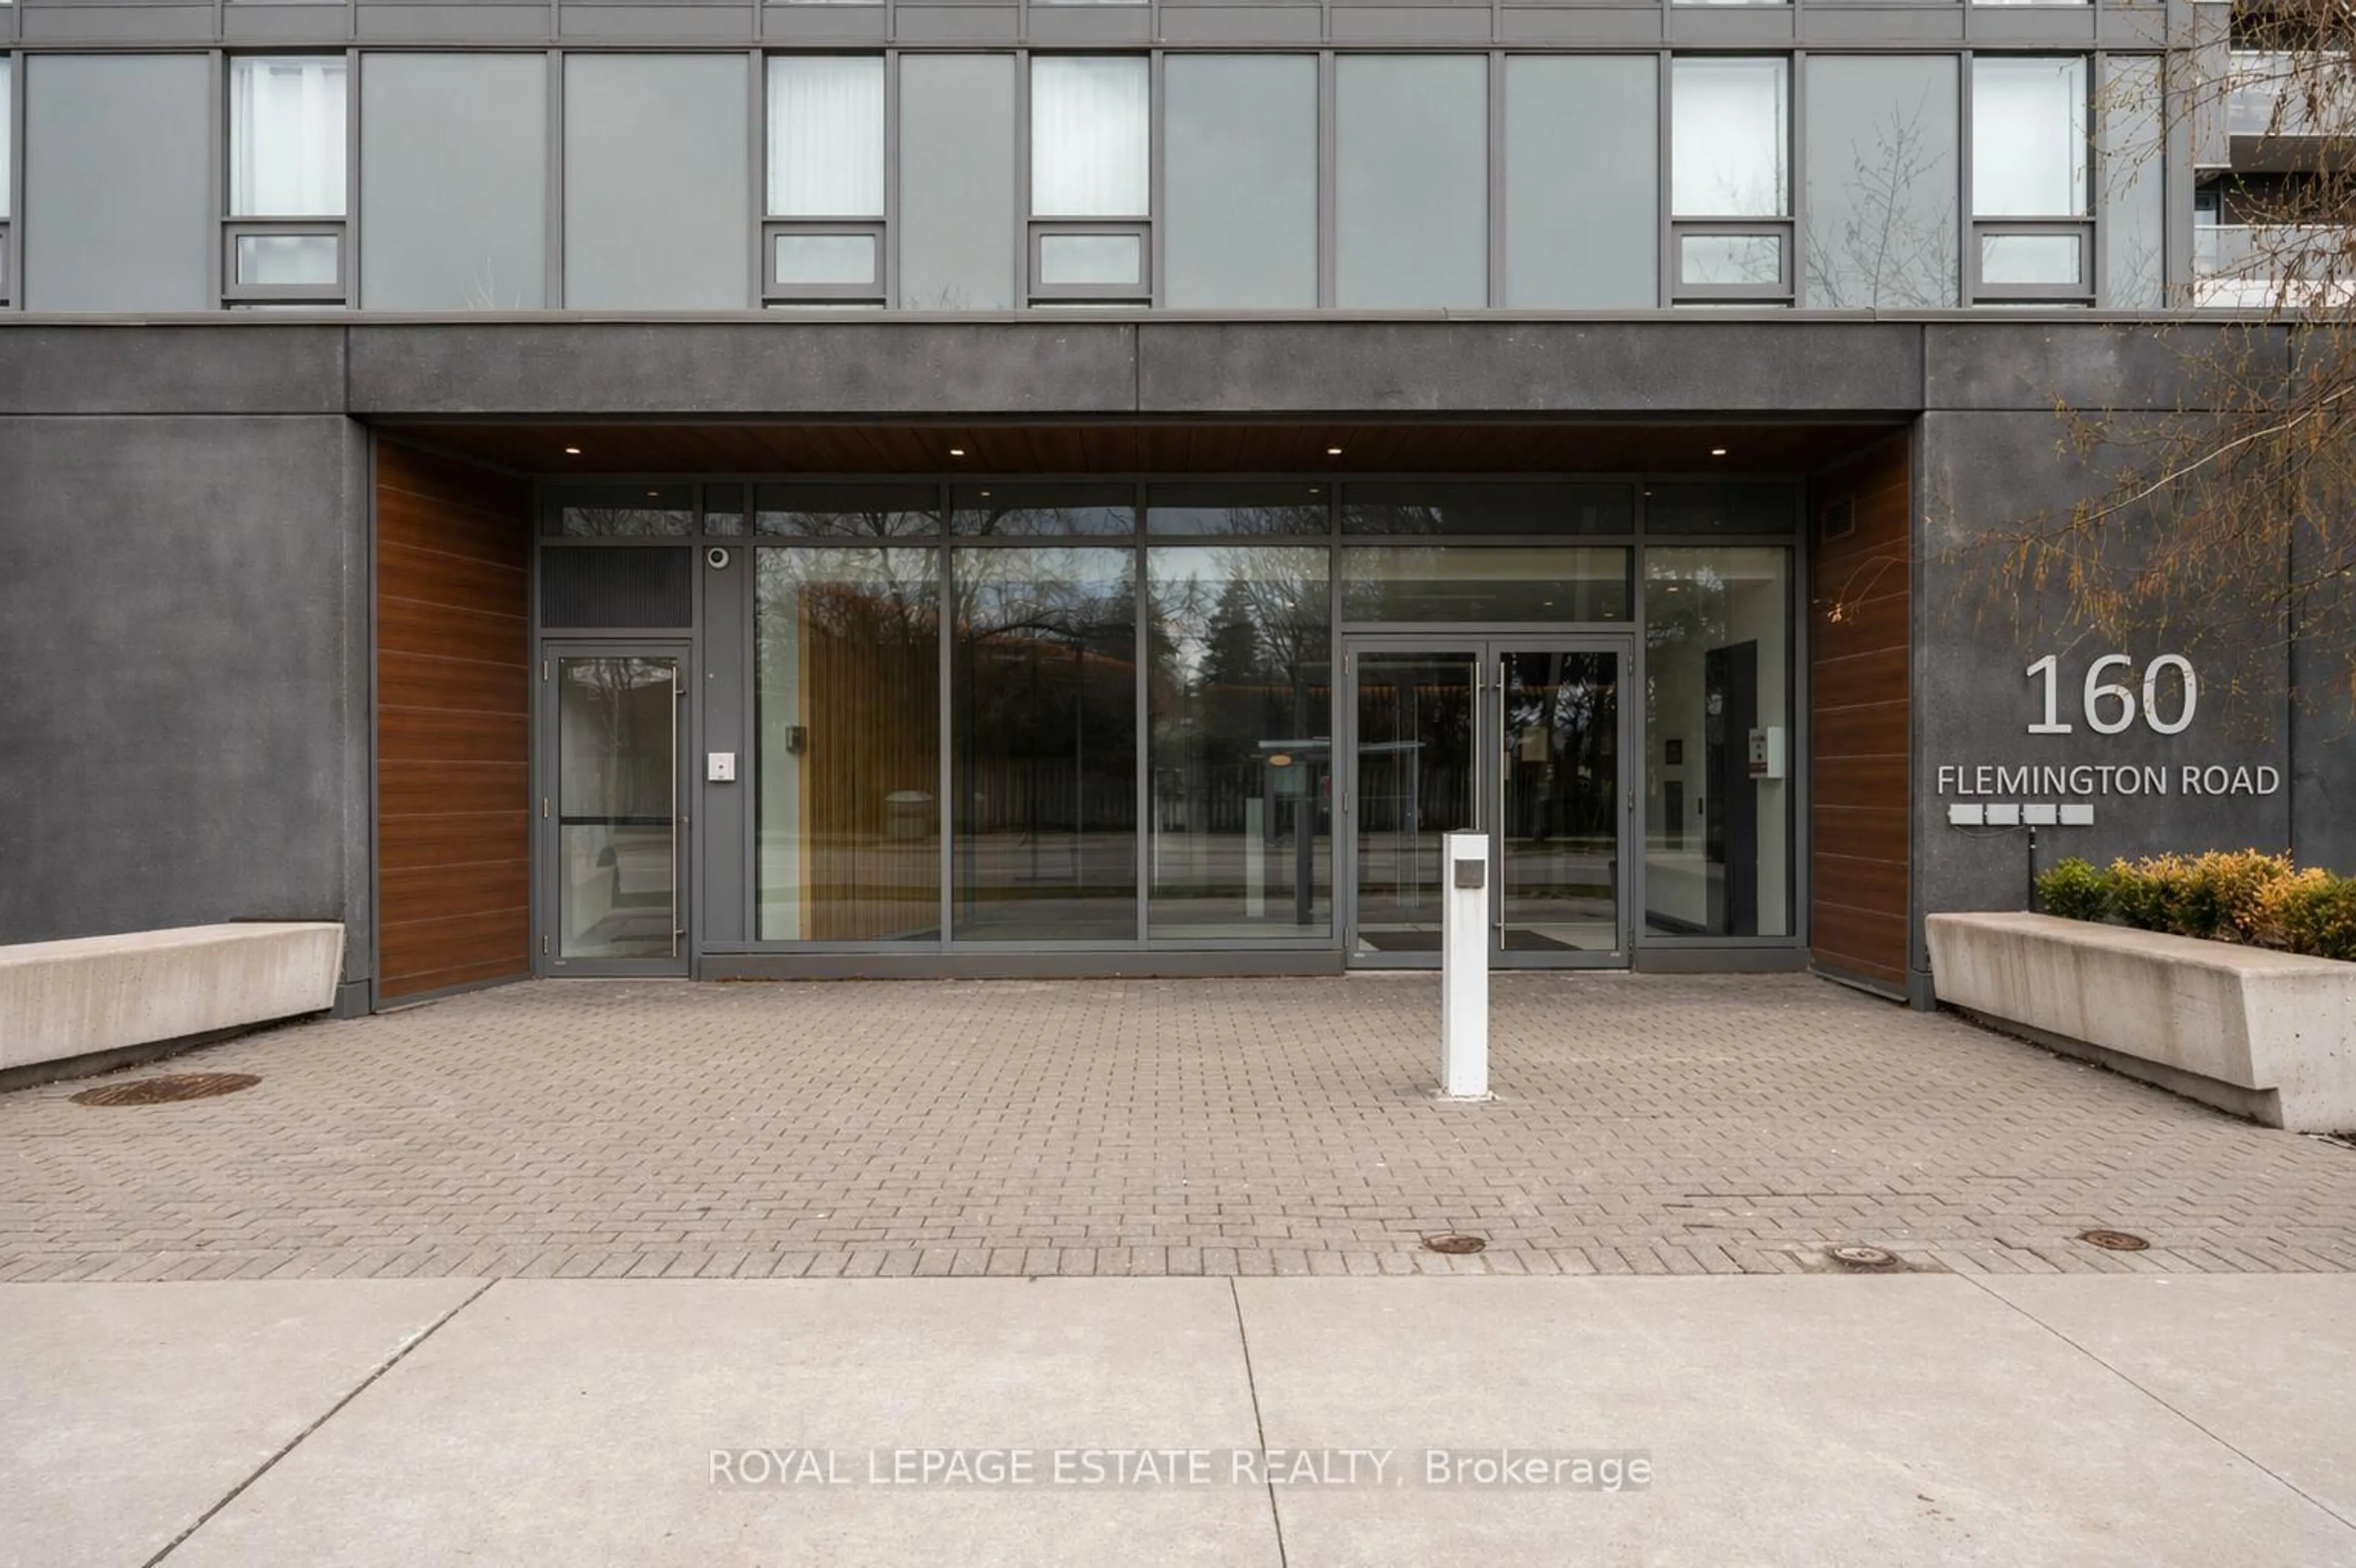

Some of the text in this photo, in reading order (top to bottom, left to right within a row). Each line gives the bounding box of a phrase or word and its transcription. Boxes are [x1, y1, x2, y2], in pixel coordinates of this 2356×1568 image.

[2026, 653, 2197, 734] 160
[1937, 765, 2280, 795] FLEMINGTON ROAD
